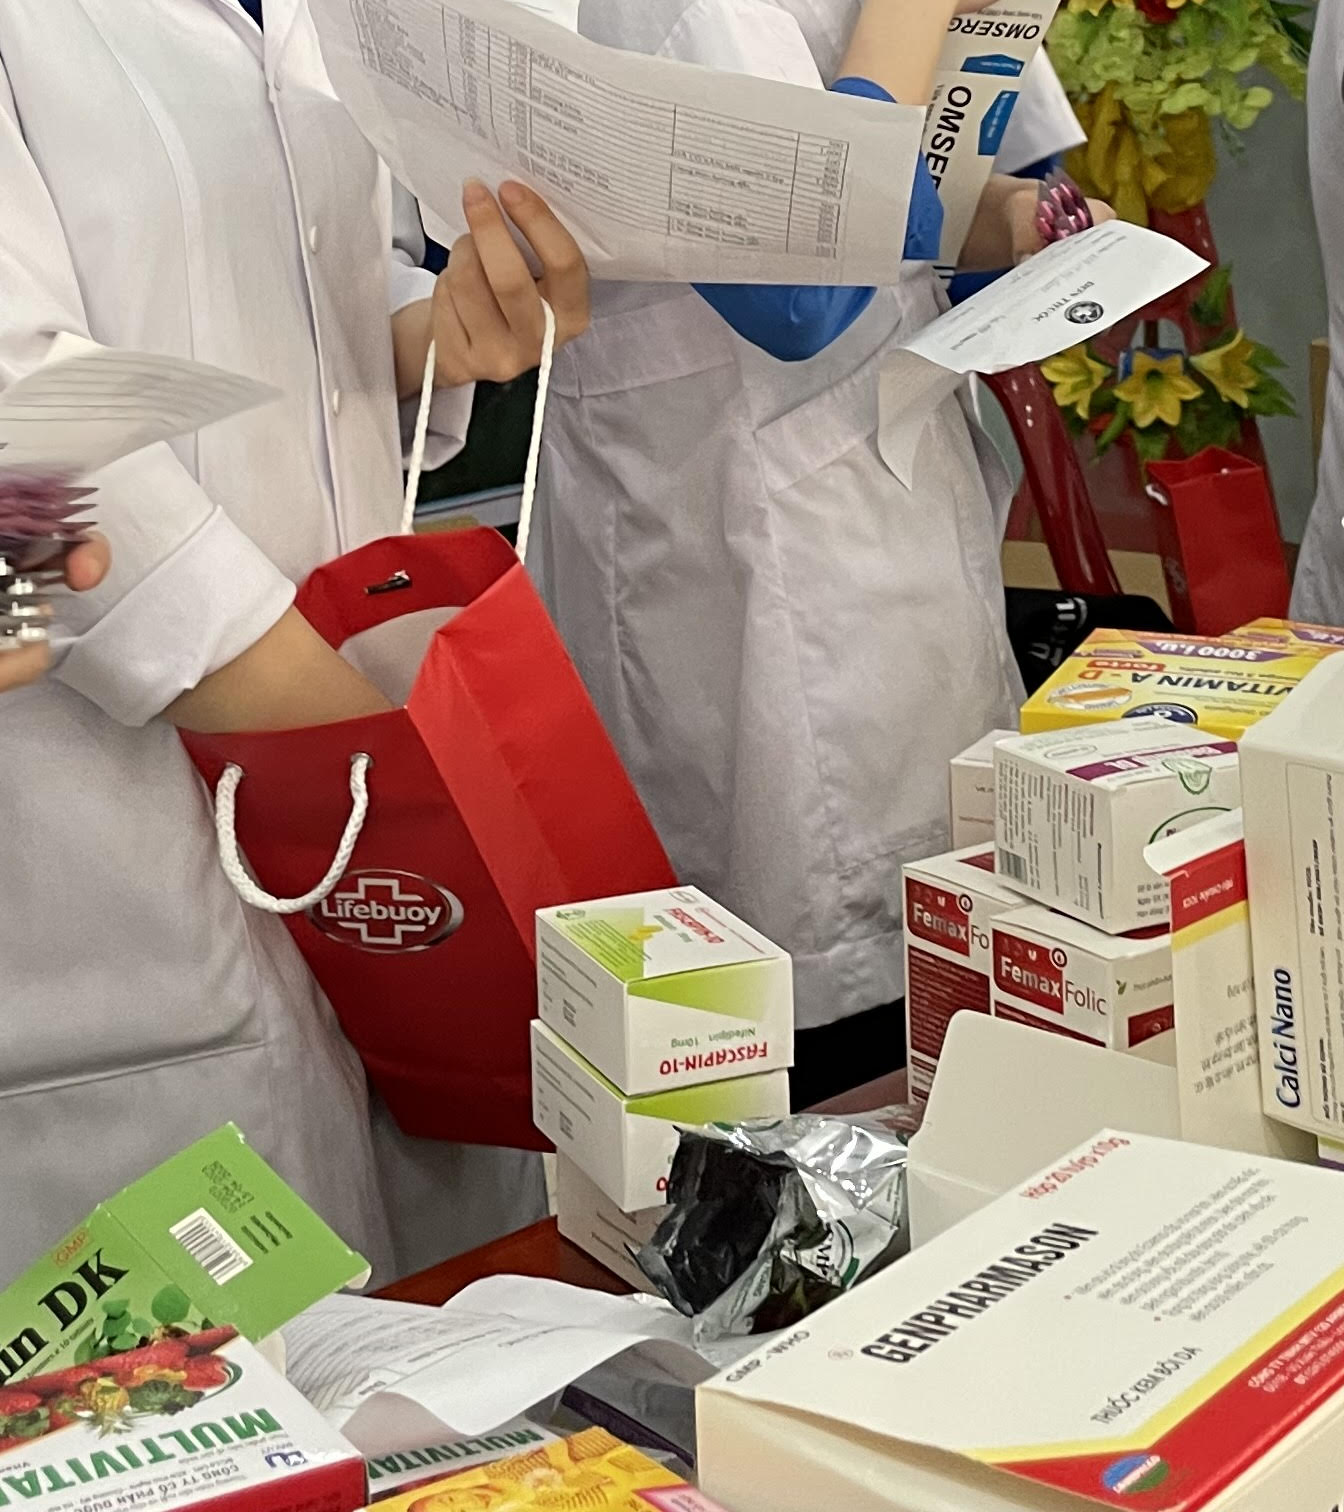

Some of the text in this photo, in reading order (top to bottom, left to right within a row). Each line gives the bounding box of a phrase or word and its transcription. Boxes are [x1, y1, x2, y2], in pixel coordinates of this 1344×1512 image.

[947, 17, 1042, 41] OMSERG
[1079, 670, 1092, 681] D
[1129, 671, 1145, 685] A
[320, 893, 444, 926] Lifebuoy
[912, 901, 990, 950] Femax Fo
[999, 956, 1107, 1016] Femax Folic
[659, 1041, 769, 1076] FASCAPIN-10
[670, 1027, 756, 1050] Nifedipin 10mg
[1271, 967, 1303, 1109] Calci Nano
[37, 1247, 130, 1332] DK
[860, 1222, 1100, 1367] GENPHARMASON
[725, 1329, 811, 1385] GMP WHO
